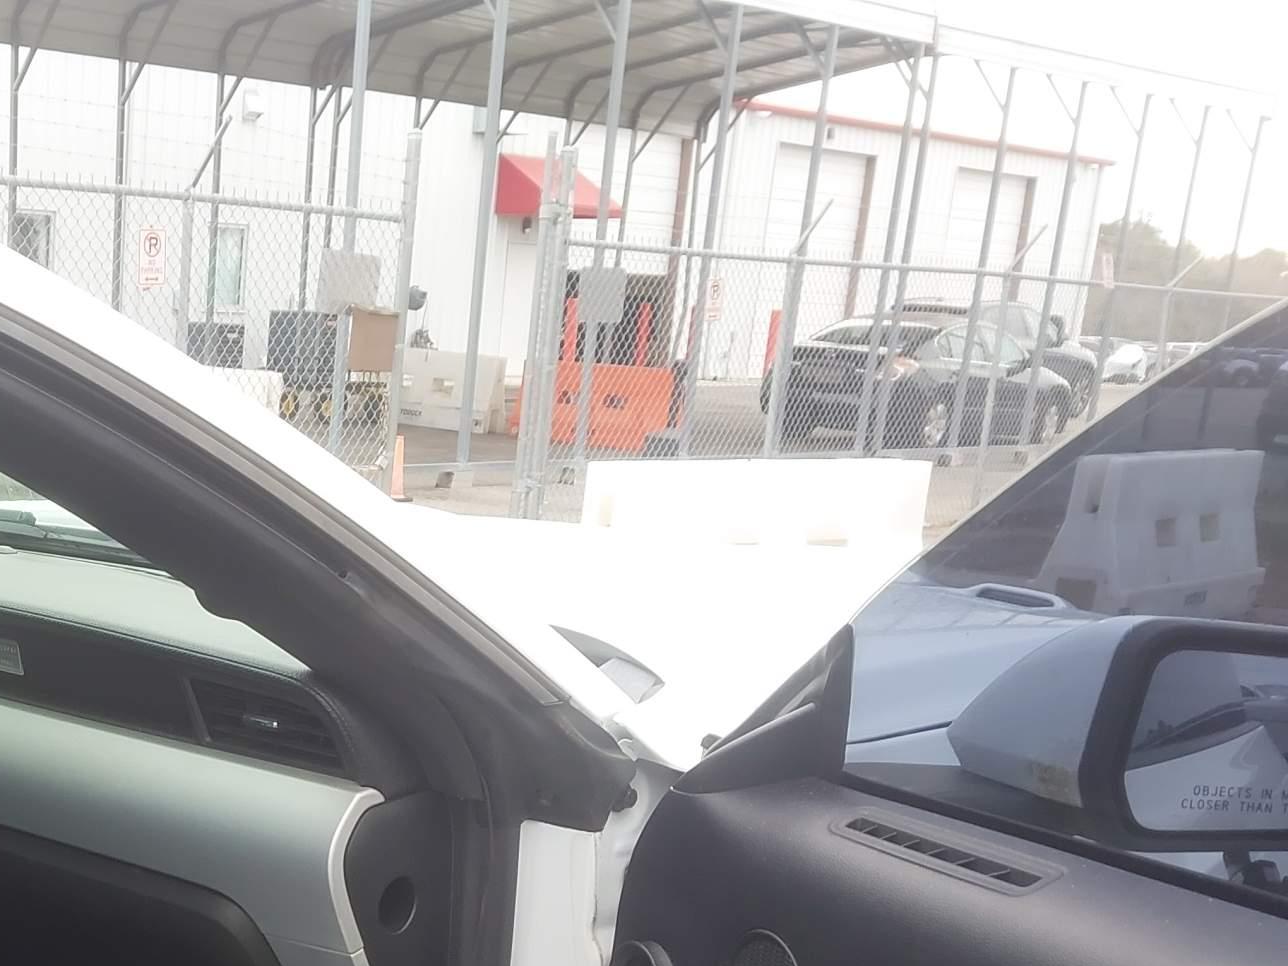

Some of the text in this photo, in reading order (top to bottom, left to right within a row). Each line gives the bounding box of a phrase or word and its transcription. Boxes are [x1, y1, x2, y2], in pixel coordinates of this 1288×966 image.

[1192, 785, 1253, 799] OBJECTS
[1261, 788, 1273, 800] IN
[1180, 798, 1230, 811] CLOSER
[1239, 800, 1273, 814] THAN
